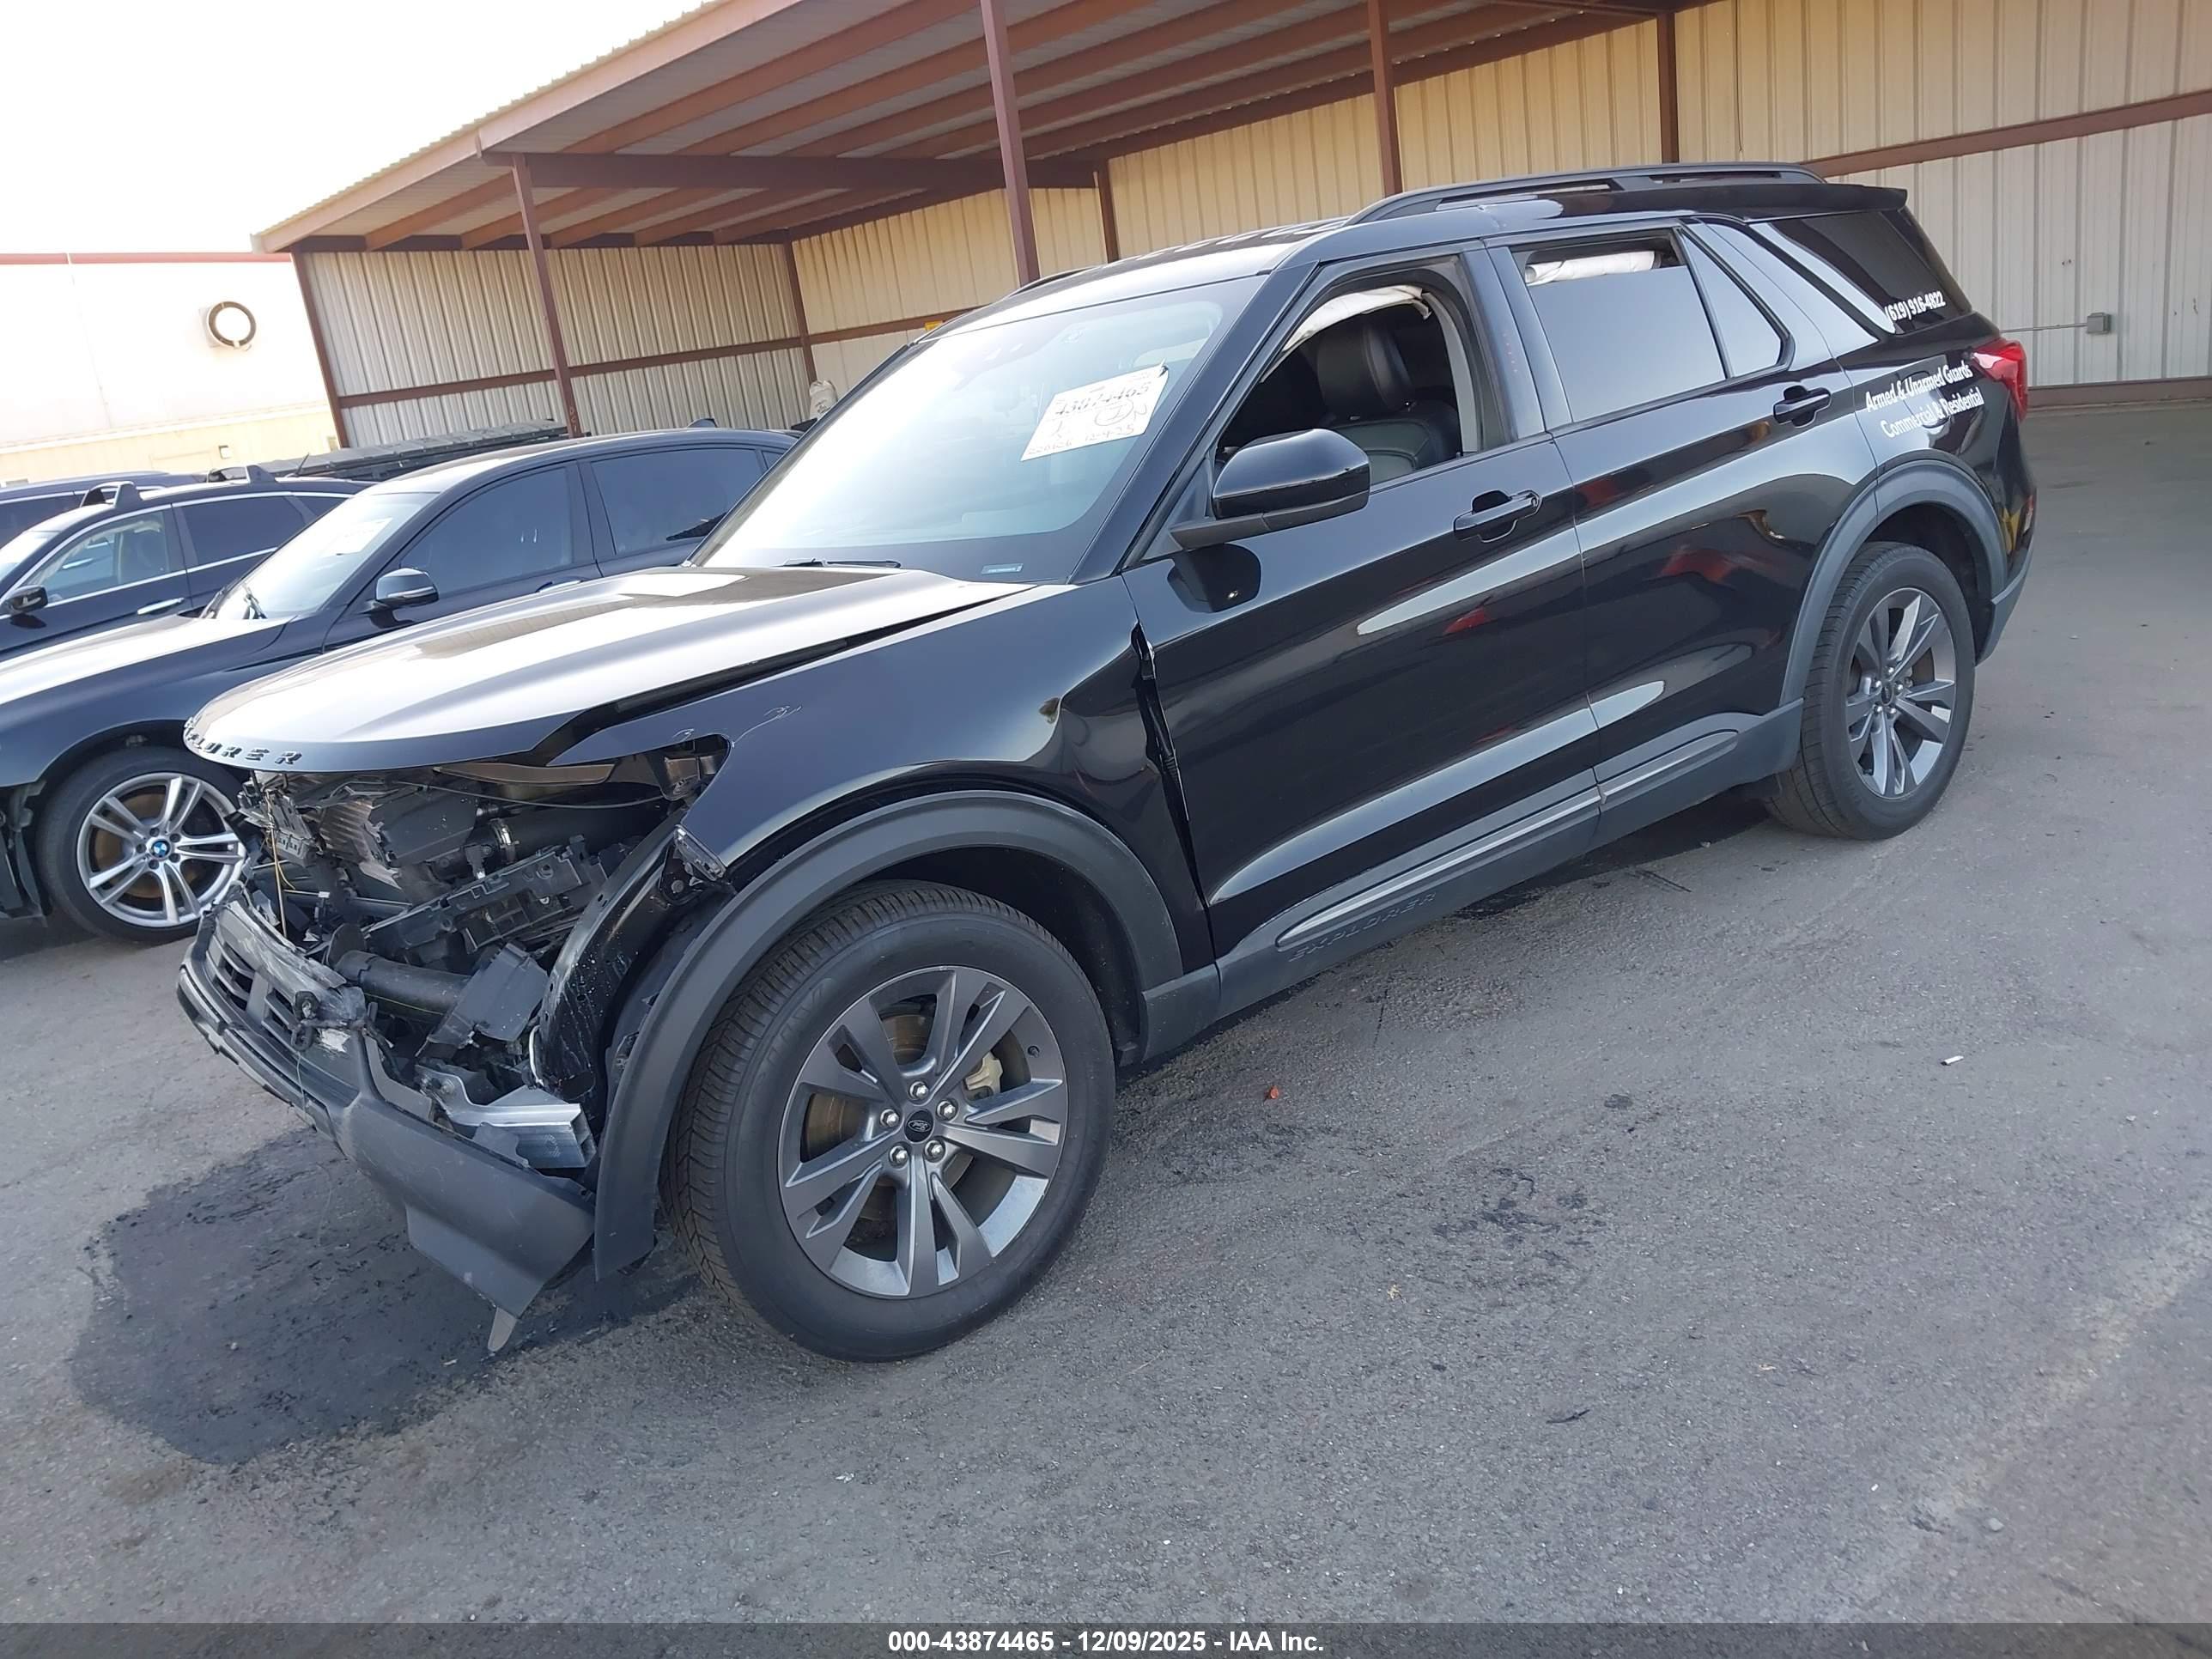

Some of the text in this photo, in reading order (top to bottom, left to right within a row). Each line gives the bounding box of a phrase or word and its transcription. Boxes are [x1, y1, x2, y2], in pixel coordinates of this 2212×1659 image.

[1886, 291, 1946, 322] (619) 916-4822
[1865, 360, 1973, 412] Armed & Unarmed Guards
[1880, 386, 1985, 438] Commercial & Residential
[1288, 893, 1437, 963] EXPLORER
